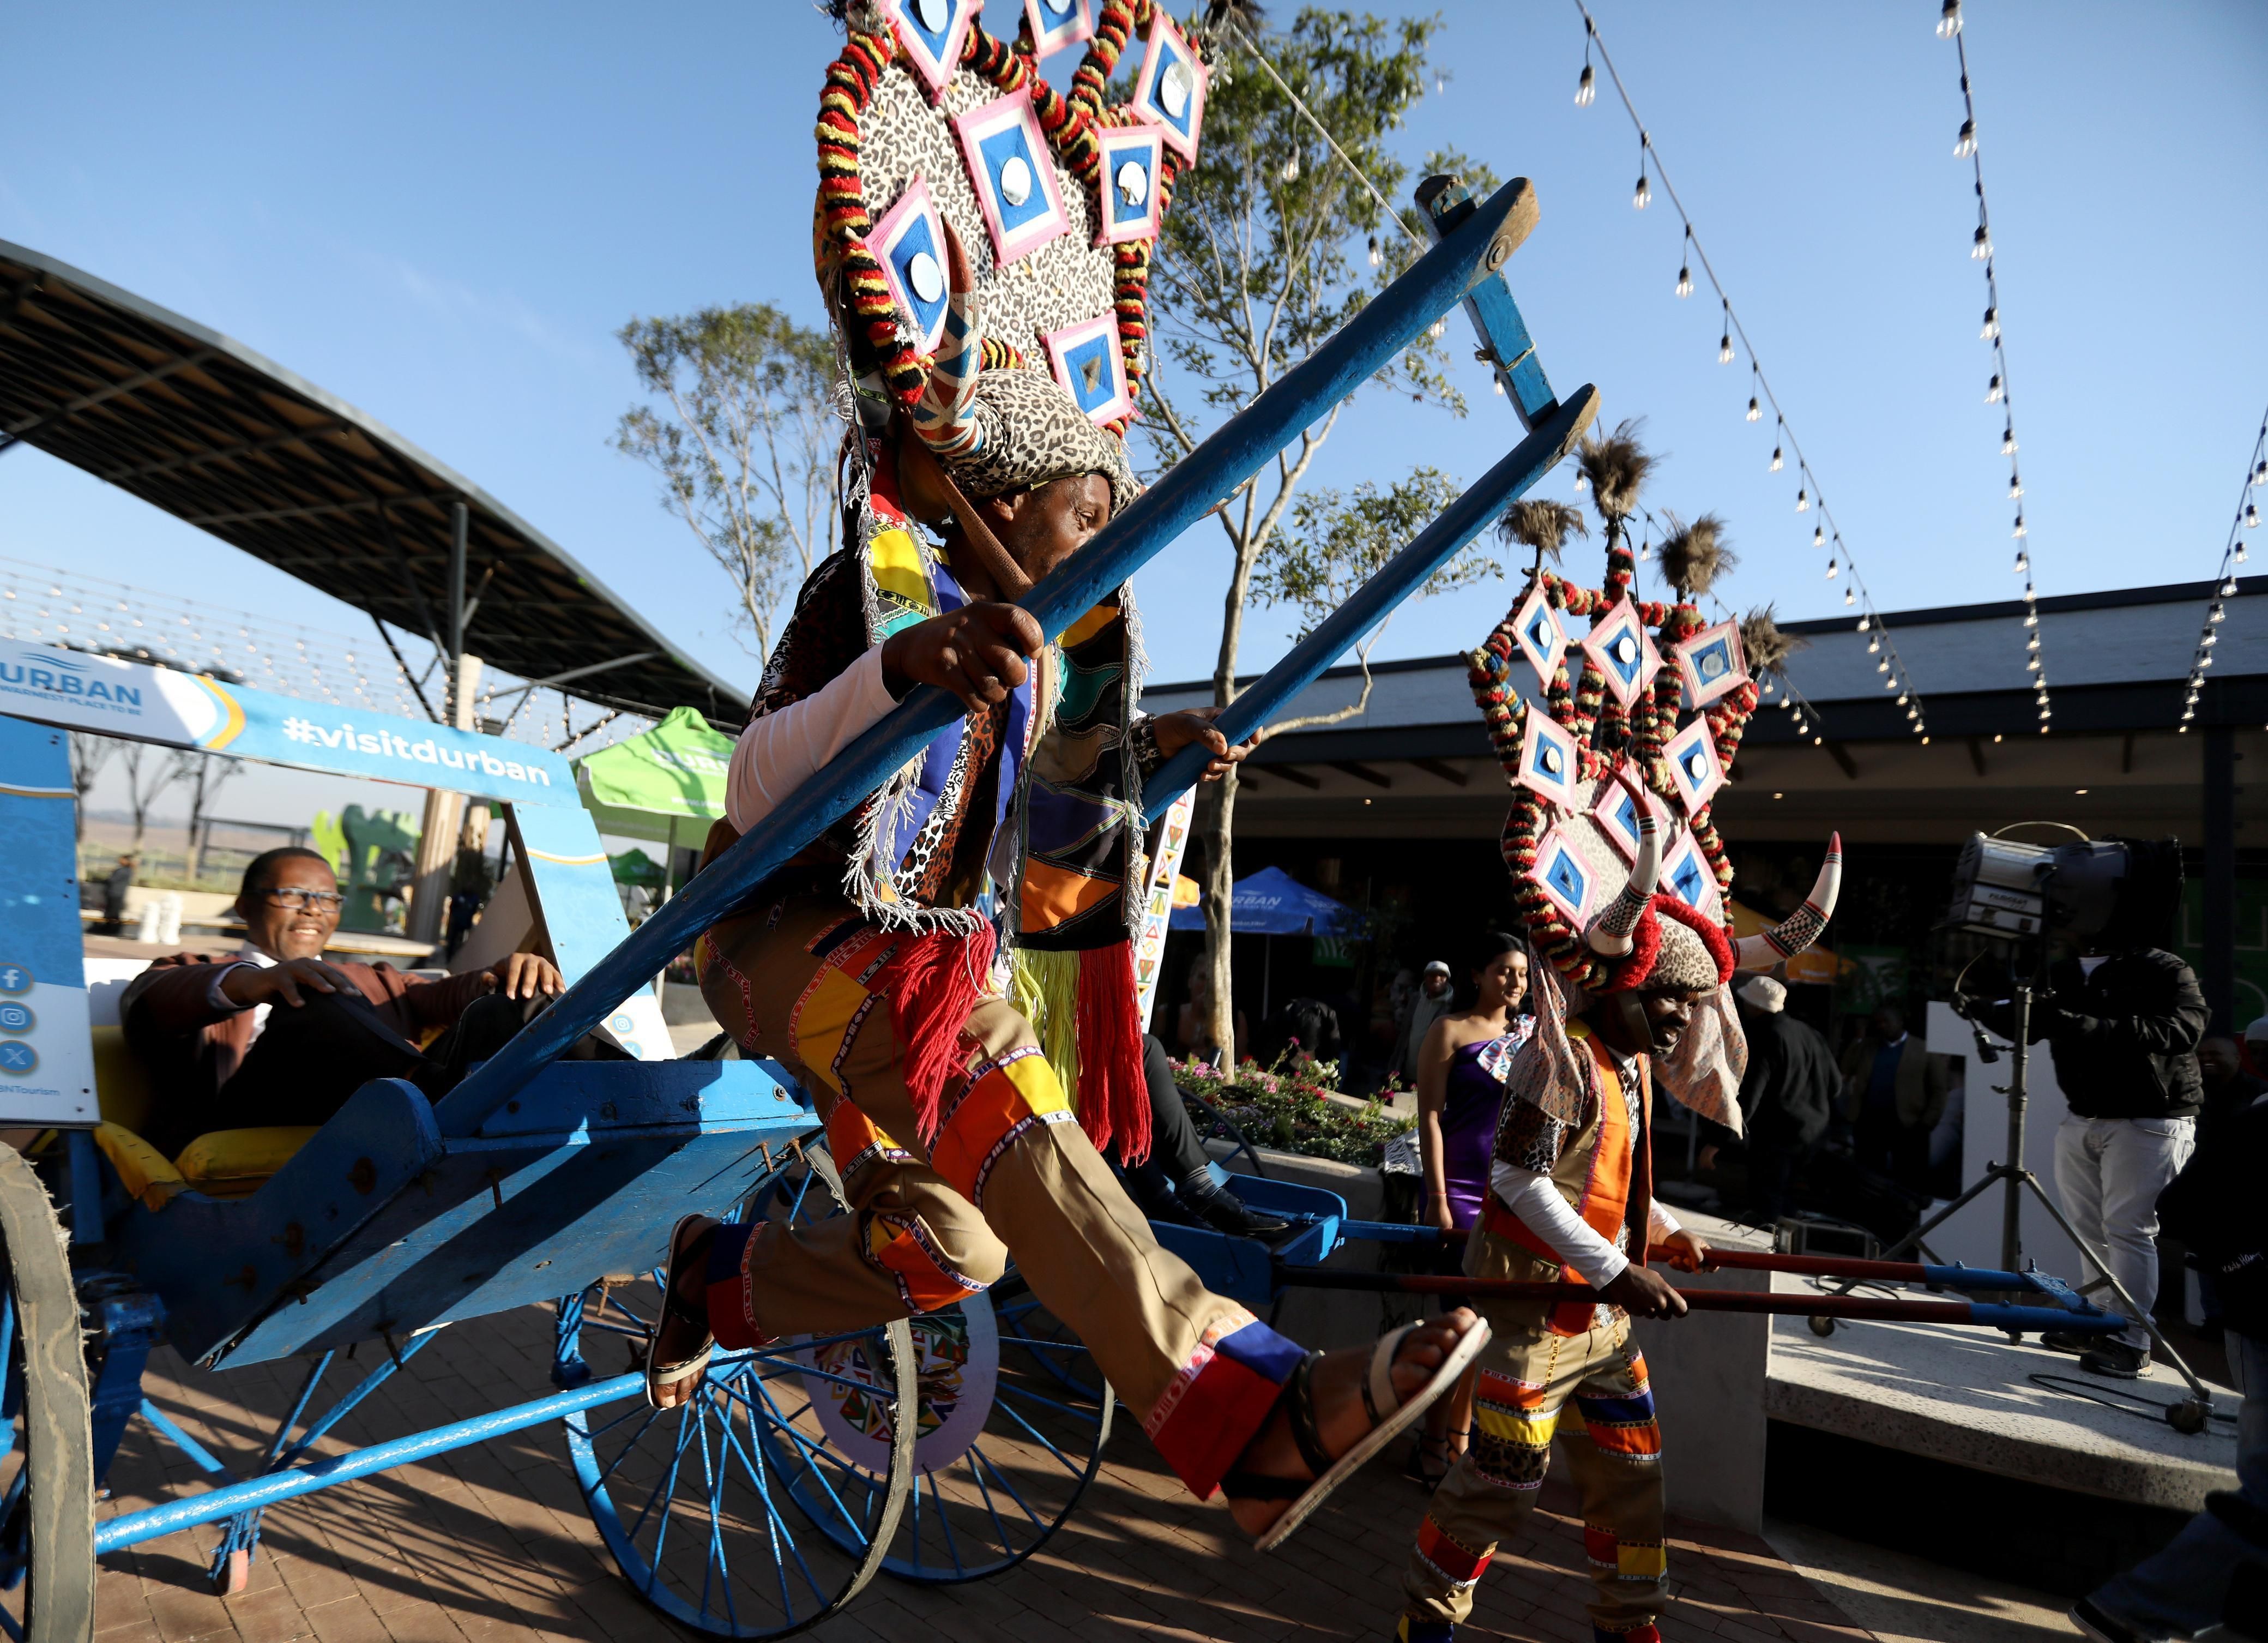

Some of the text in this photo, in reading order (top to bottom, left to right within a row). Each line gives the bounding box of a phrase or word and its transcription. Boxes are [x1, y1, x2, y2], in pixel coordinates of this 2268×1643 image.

[0, 662, 141, 706] URBAN
[69, 697, 106, 710] PLACE
[111, 704, 125, 713] TO
[128, 708, 142, 716] BE
[282, 715, 550, 786] #visitdurban
